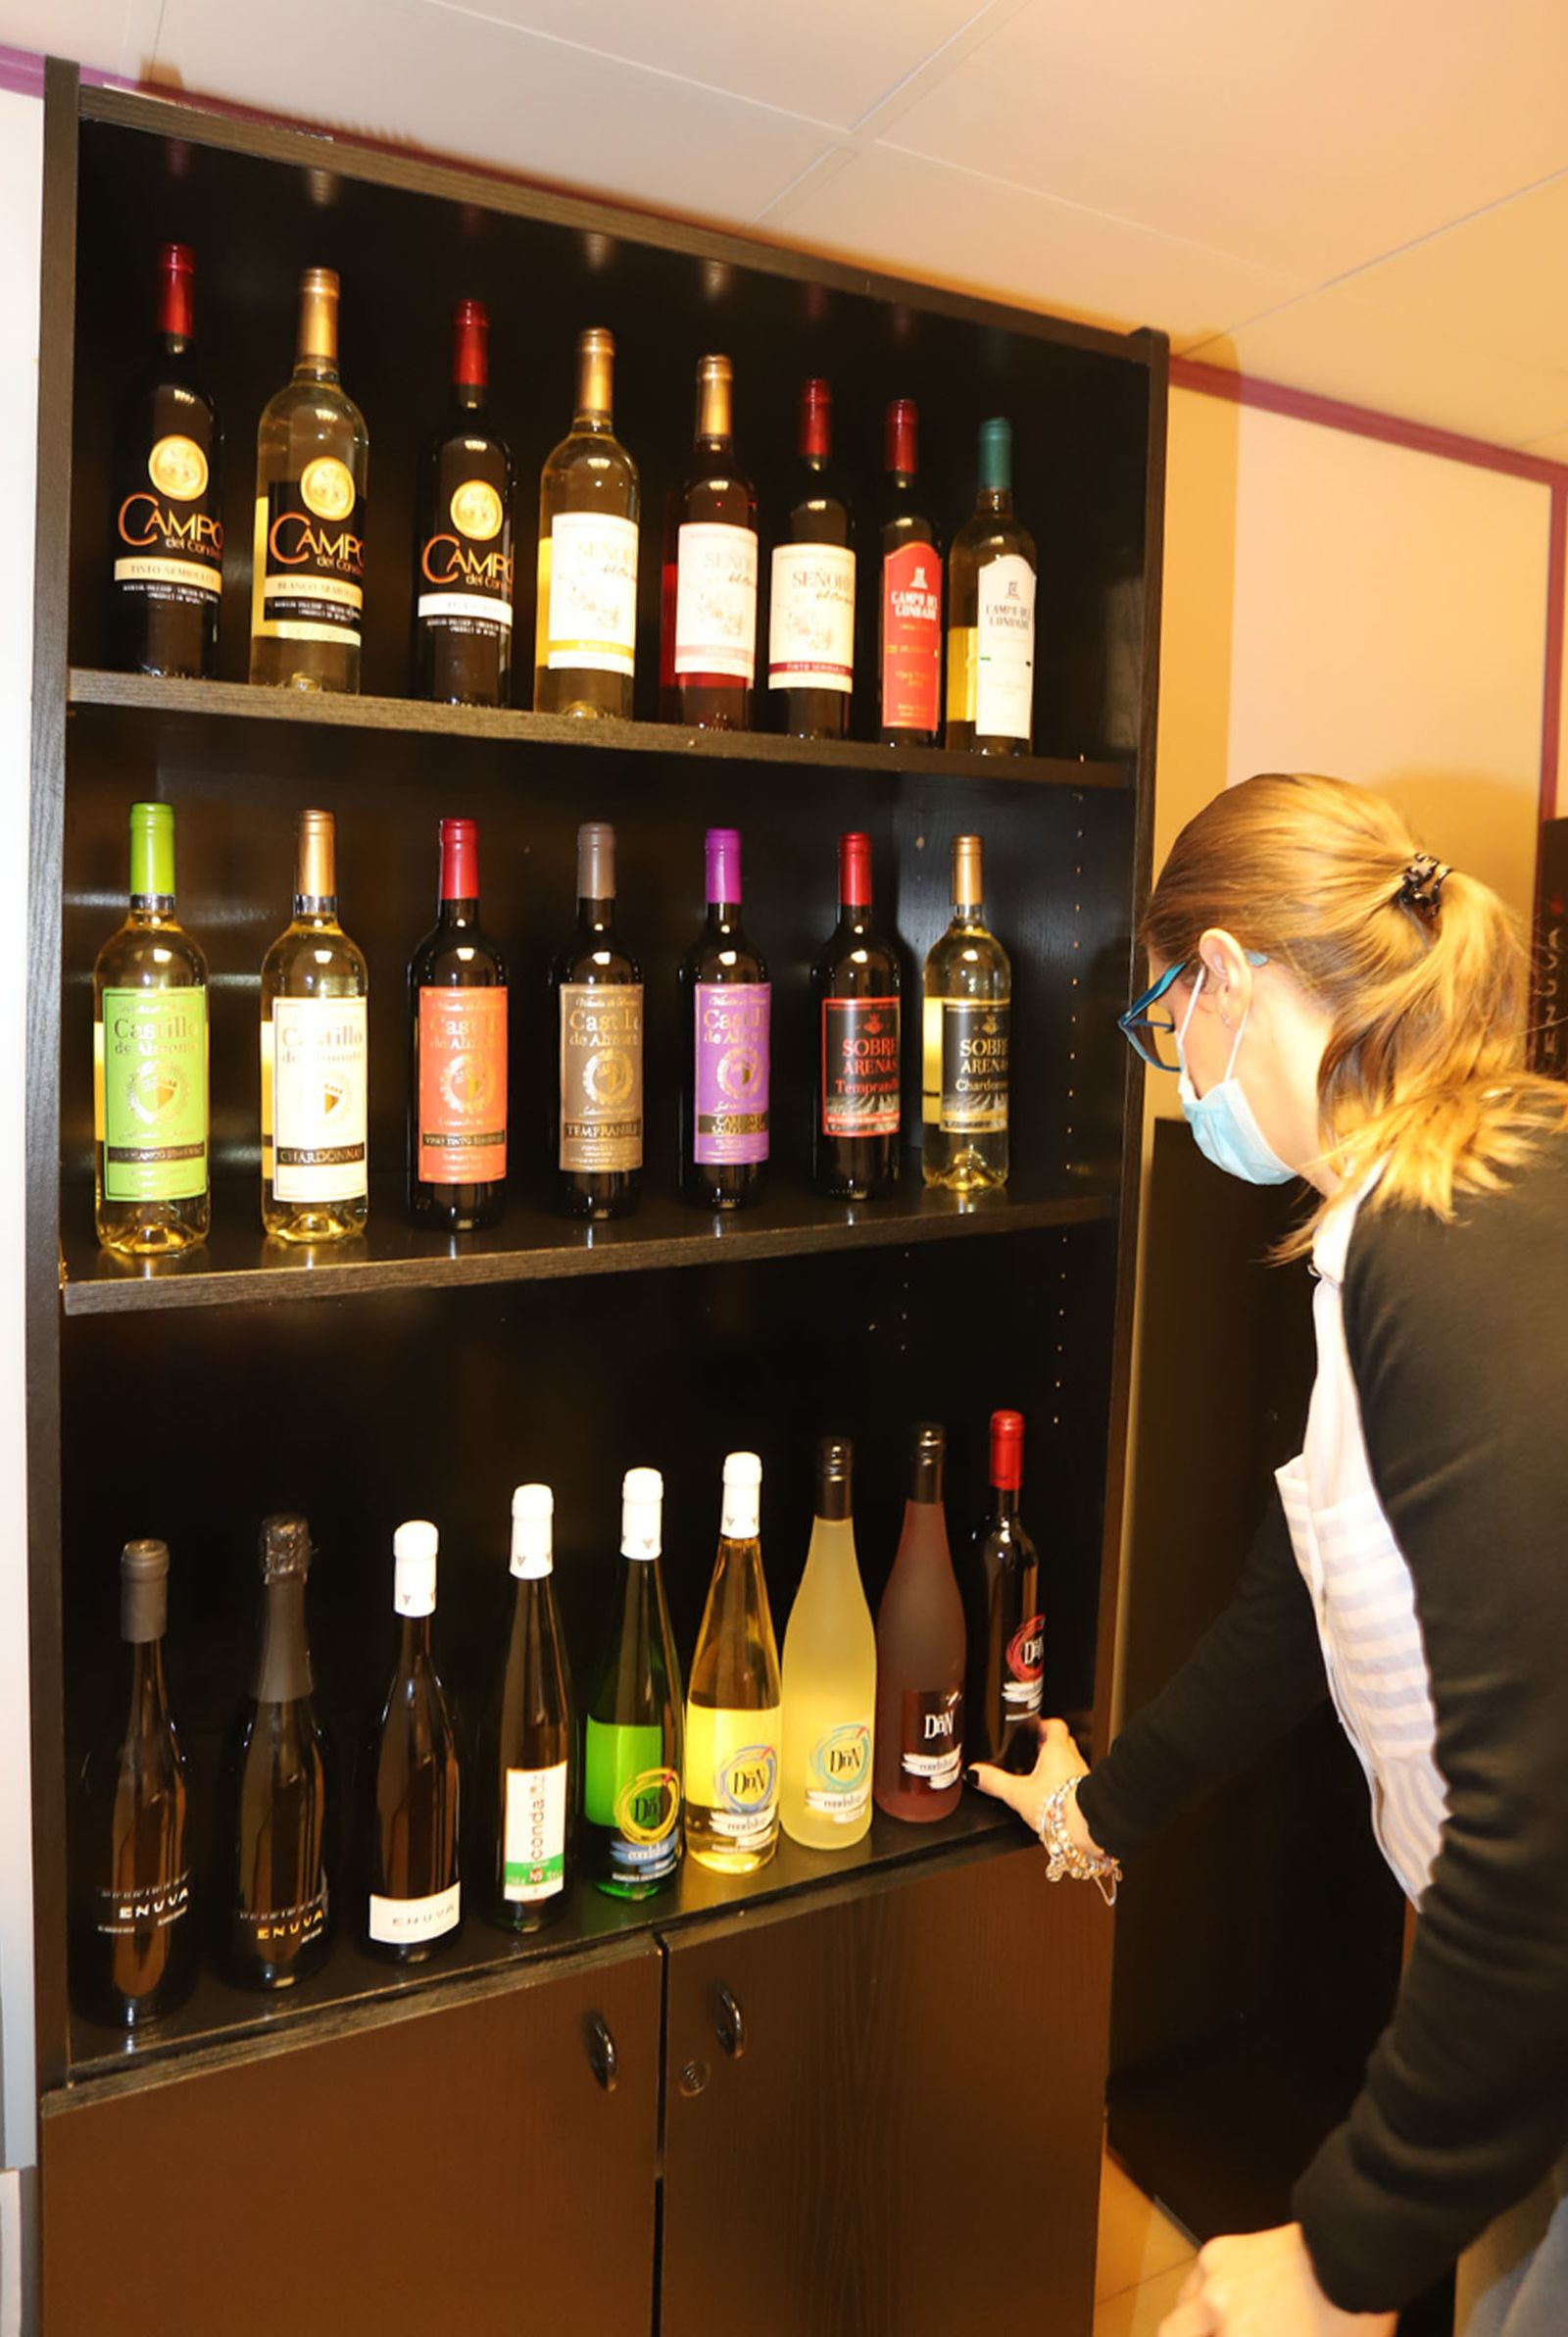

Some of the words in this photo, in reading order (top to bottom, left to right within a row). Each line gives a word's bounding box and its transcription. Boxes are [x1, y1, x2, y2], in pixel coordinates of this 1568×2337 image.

[119, 493, 223, 546] CAMPO
[114, 1016, 199, 1040] Castillo
[282, 1026, 363, 1048] Cstillo
[115, 1040, 131, 1055] de
[119, 1888, 188, 1918] ENUVA
[257, 1910, 323, 1940] ENUVA
